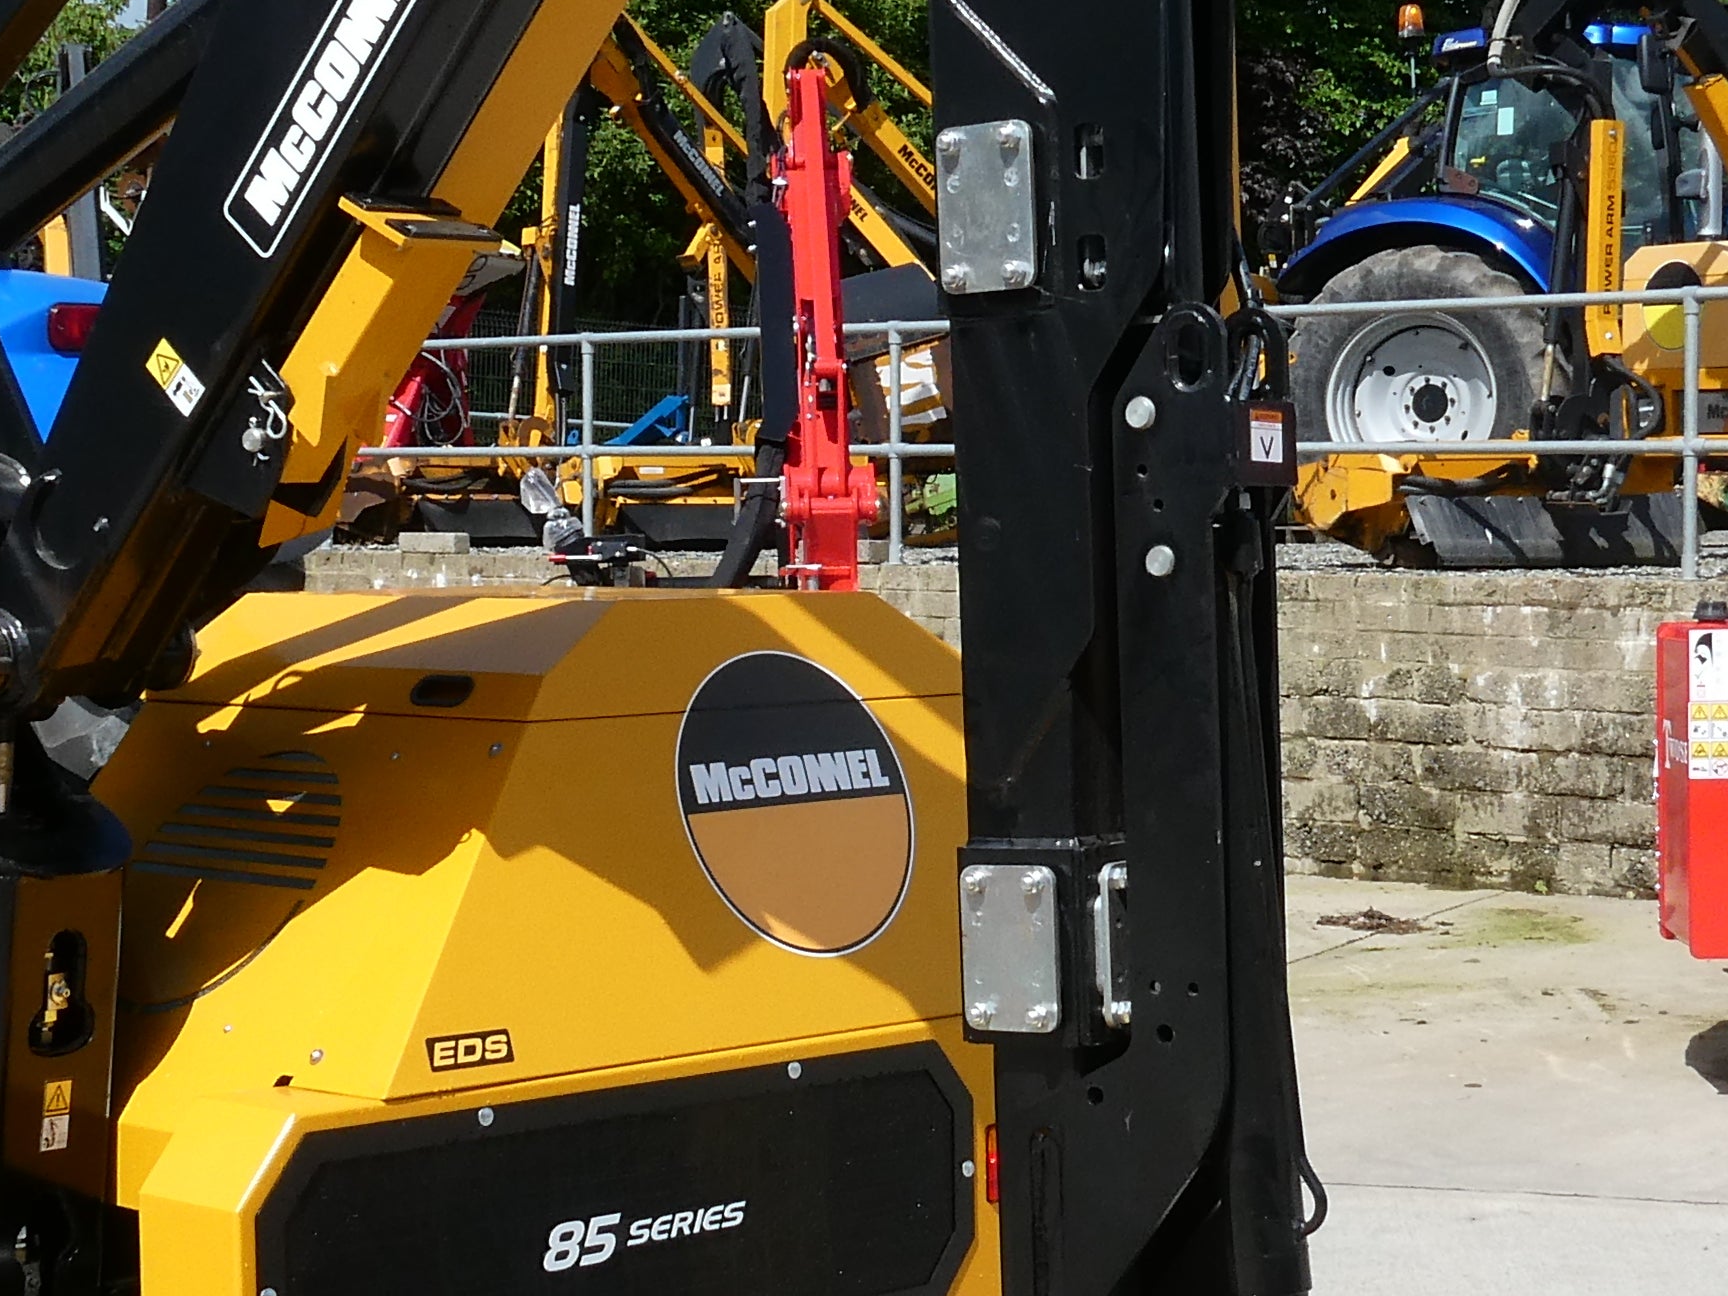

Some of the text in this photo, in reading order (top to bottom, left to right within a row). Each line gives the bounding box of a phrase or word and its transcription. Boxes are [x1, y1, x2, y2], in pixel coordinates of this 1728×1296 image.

[1602, 247, 1614, 316] PWER
[689, 748, 891, 805] McCONNEL
[433, 1034, 509, 1067] EDS
[543, 1200, 747, 1272] 85 SERIES
